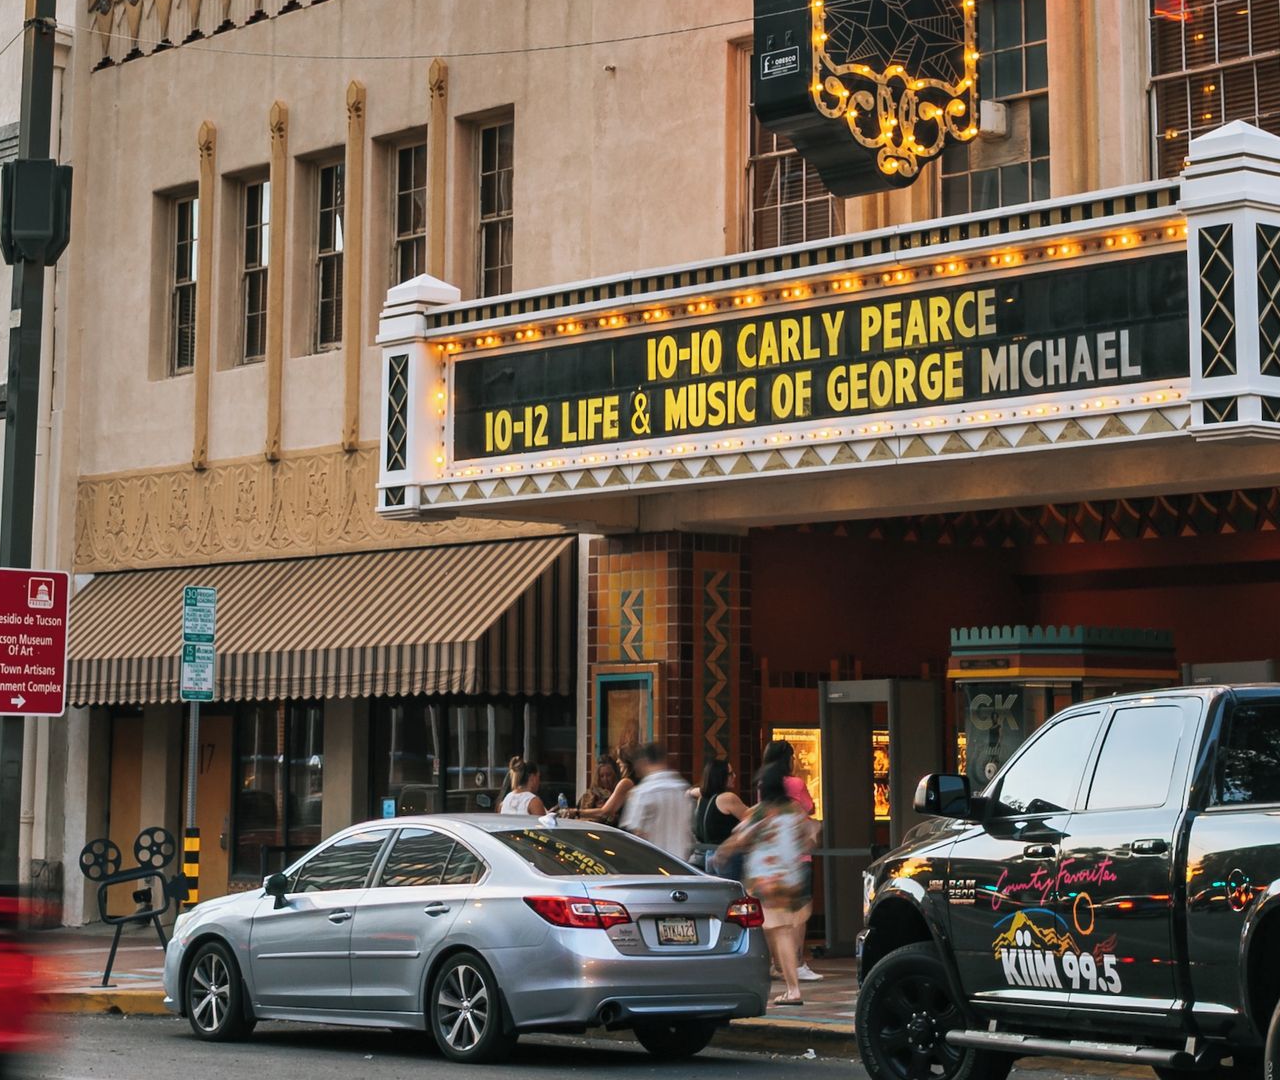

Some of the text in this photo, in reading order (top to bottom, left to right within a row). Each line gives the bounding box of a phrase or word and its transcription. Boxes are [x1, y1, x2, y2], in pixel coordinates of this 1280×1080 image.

[646, 288, 997, 381] 10-10 CARLY PEARCE
[485, 329, 1141, 452] 10-12 LIFE & MUSIC OF GEORGE MICHAEL
[186, 589, 196, 598] 30
[23, 614, 35, 624] de
[36, 615, 62, 626] Tucson
[19, 634, 53, 646] Museum
[8, 645, 33, 656] Of Art
[0, 663, 22, 674] Town
[24, 664, 55, 676] Artisans
[27, 681, 61, 695] Complex
[949, 879, 976, 888] RAM
[991, 867, 1054, 910] Country
[949, 889, 975, 898] 2500
[1062, 951, 1122, 993] 99.5
